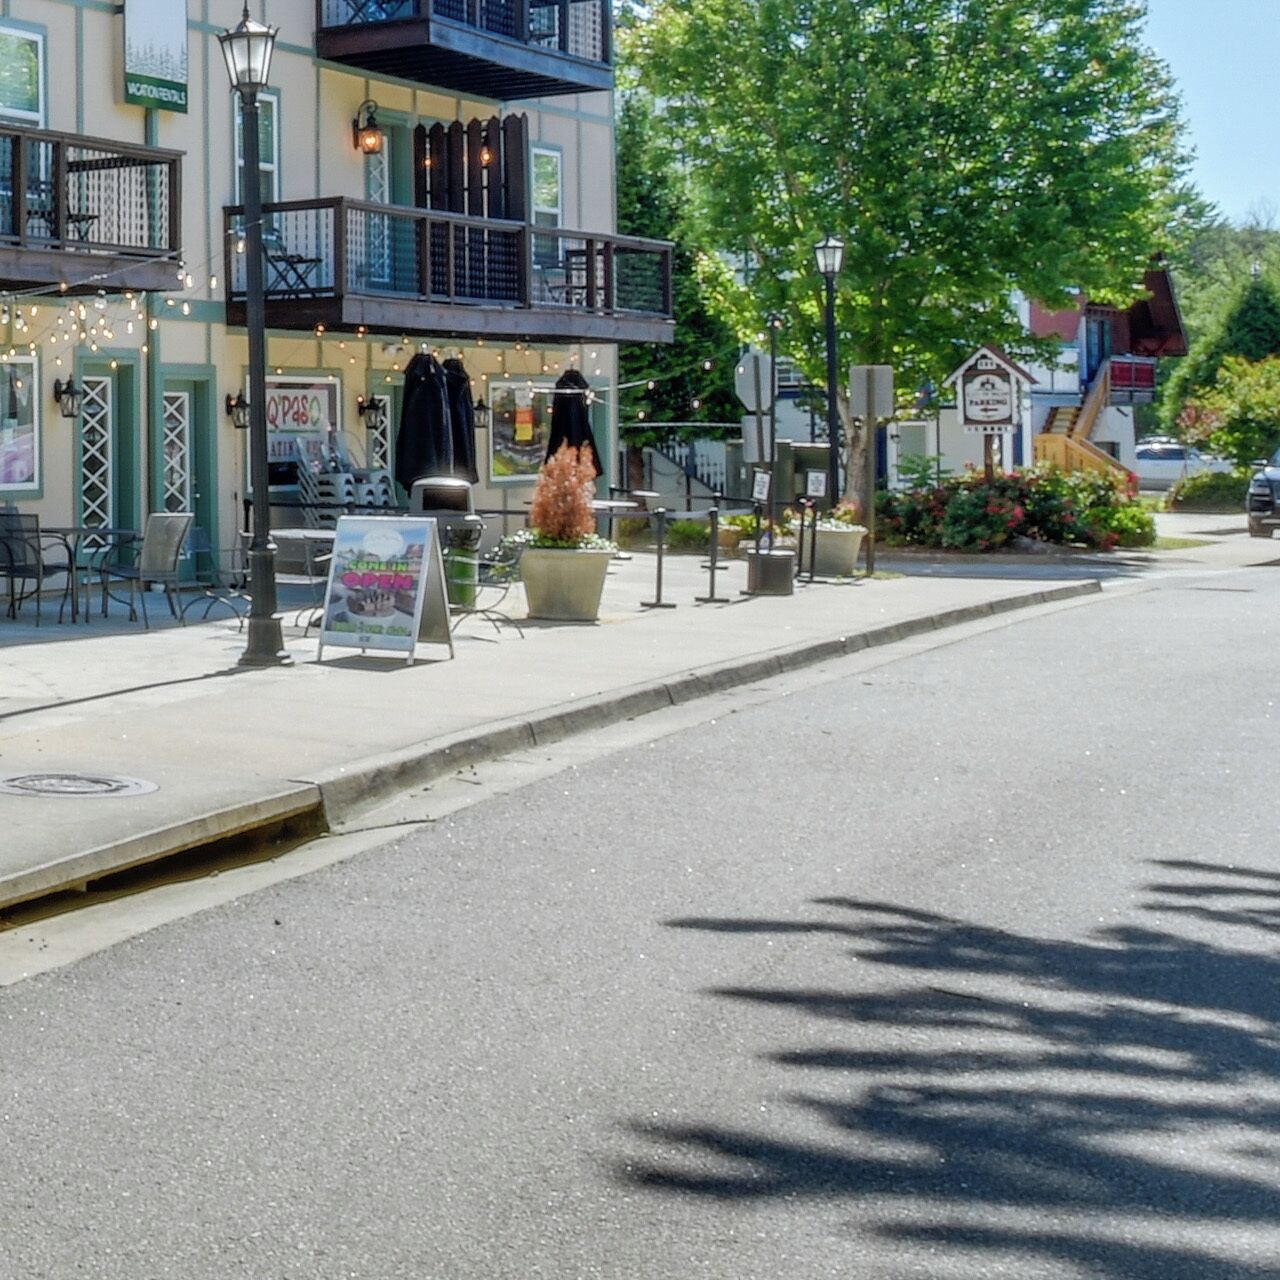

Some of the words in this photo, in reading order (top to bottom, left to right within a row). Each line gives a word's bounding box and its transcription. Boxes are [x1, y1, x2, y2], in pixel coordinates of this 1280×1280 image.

[349, 560, 387, 571] COME
[390, 561, 408, 572] IN
[341, 571, 413, 591] OPEN
